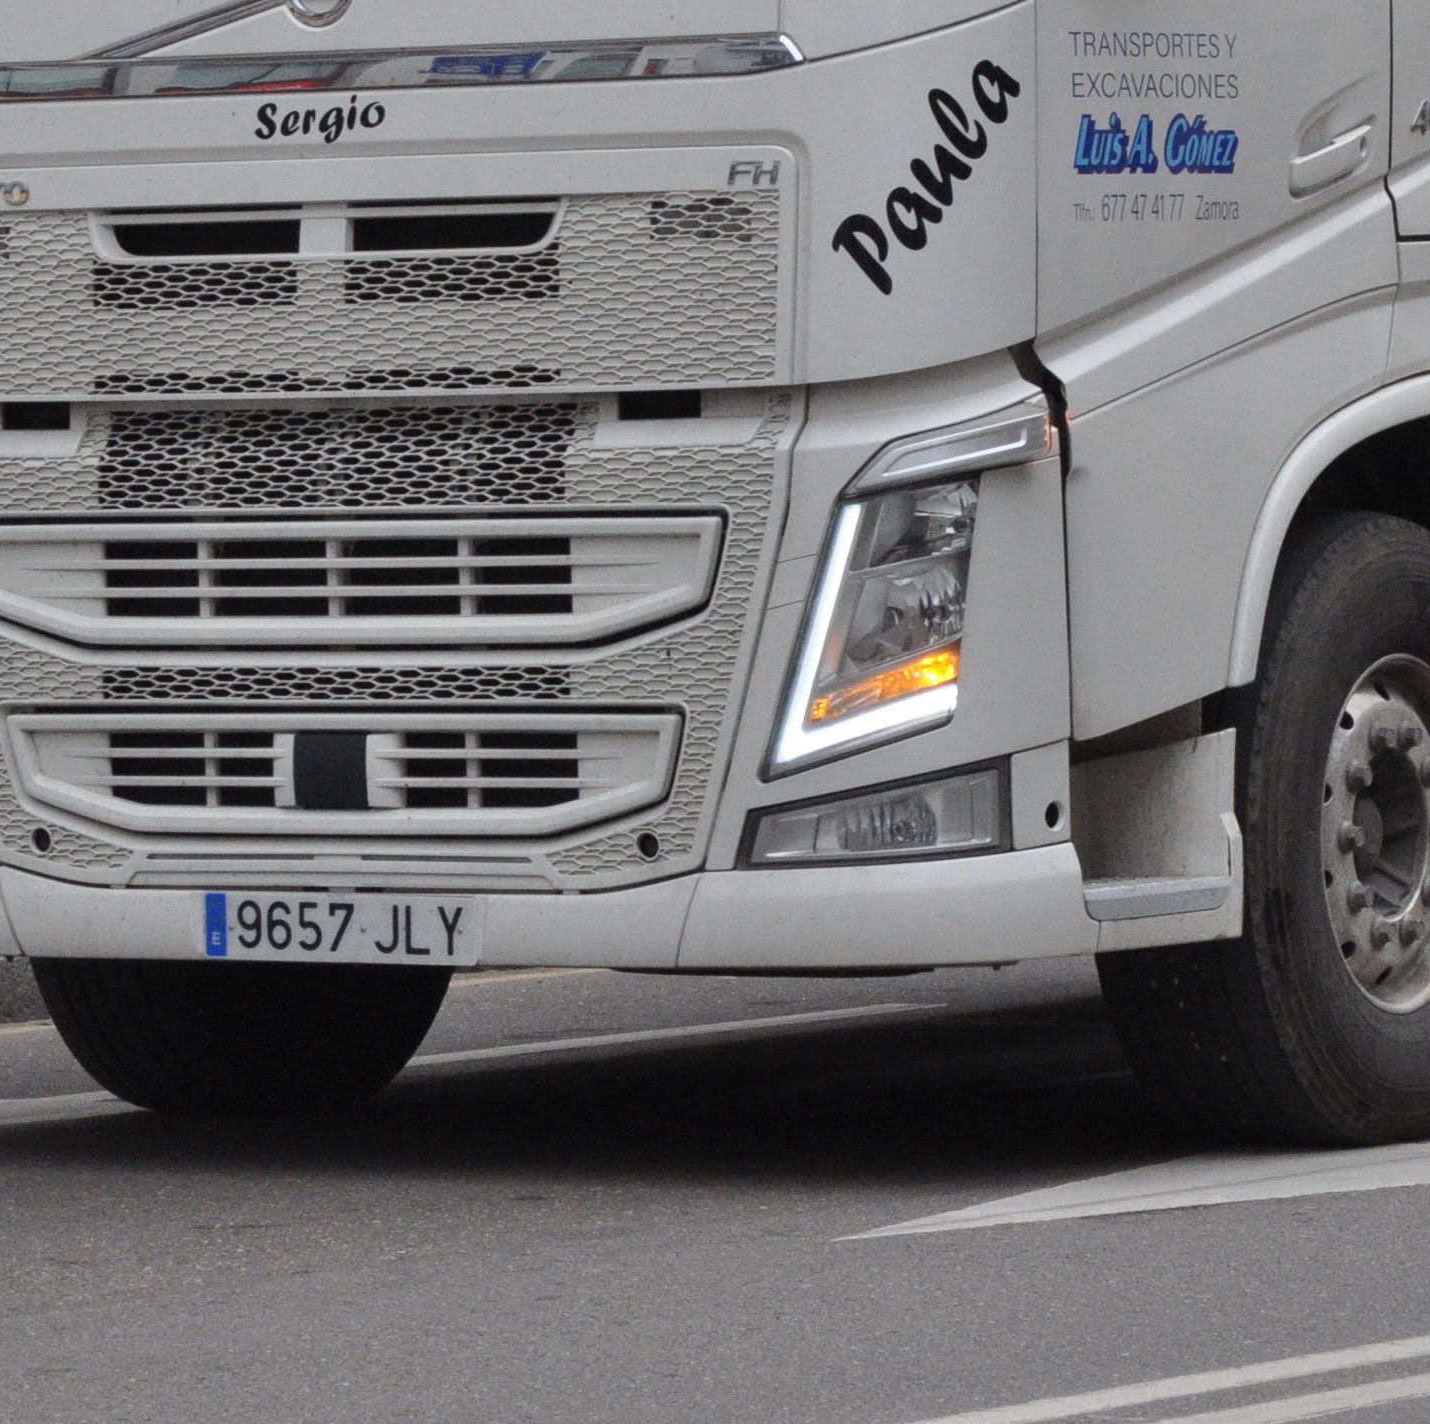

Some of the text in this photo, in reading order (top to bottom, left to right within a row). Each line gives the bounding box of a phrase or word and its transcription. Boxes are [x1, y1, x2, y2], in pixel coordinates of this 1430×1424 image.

[1069, 32, 1237, 58] TRANSPORTES Y
[1072, 72, 1239, 99] EXCAVACIONES
[255, 94, 386, 144] Sergio
[1127, 114, 1158, 174] A.
[727, 160, 781, 185] FH
[832, 59, 1021, 296] Paula
[1101, 194, 1126, 222] 677
[1131, 194, 1147, 221] 47
[1151, 194, 1165, 221] 41
[1170, 194, 1184, 221] 77
[1195, 195, 1240, 221] Zamora
[237, 900, 355, 952] 9657
[375, 904, 463, 956] JLY
